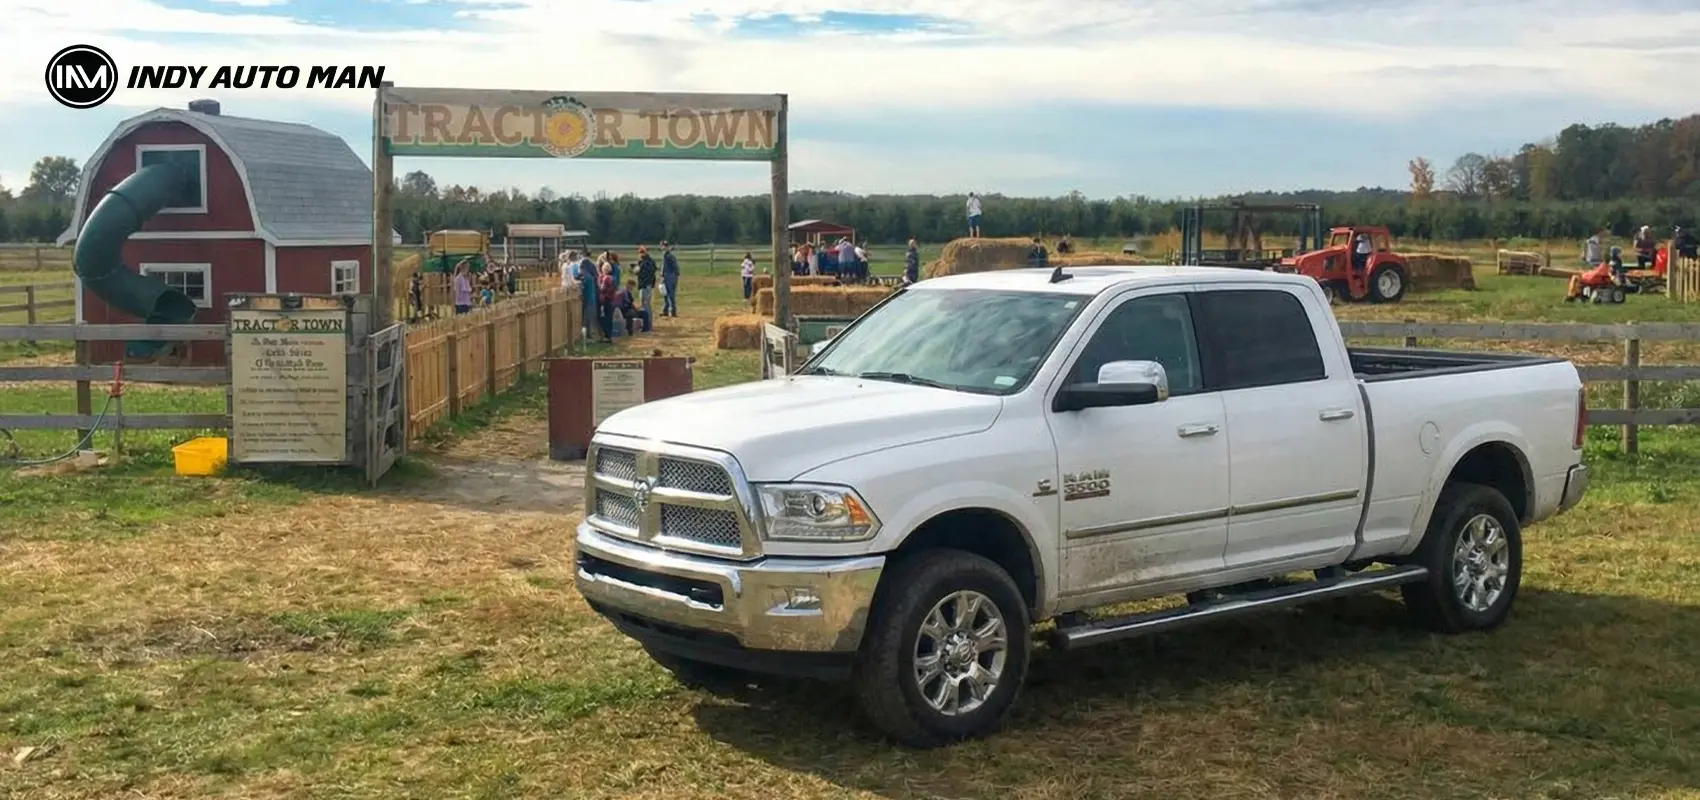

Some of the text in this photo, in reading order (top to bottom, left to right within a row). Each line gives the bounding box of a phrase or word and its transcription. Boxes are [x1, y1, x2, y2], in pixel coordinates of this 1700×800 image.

[385, 100, 625, 157] TRACTOR
[638, 106, 777, 149] TOWN
[233, 318, 343, 331] TRACTOR TOWN
[1063, 479, 1110, 494] 3500
